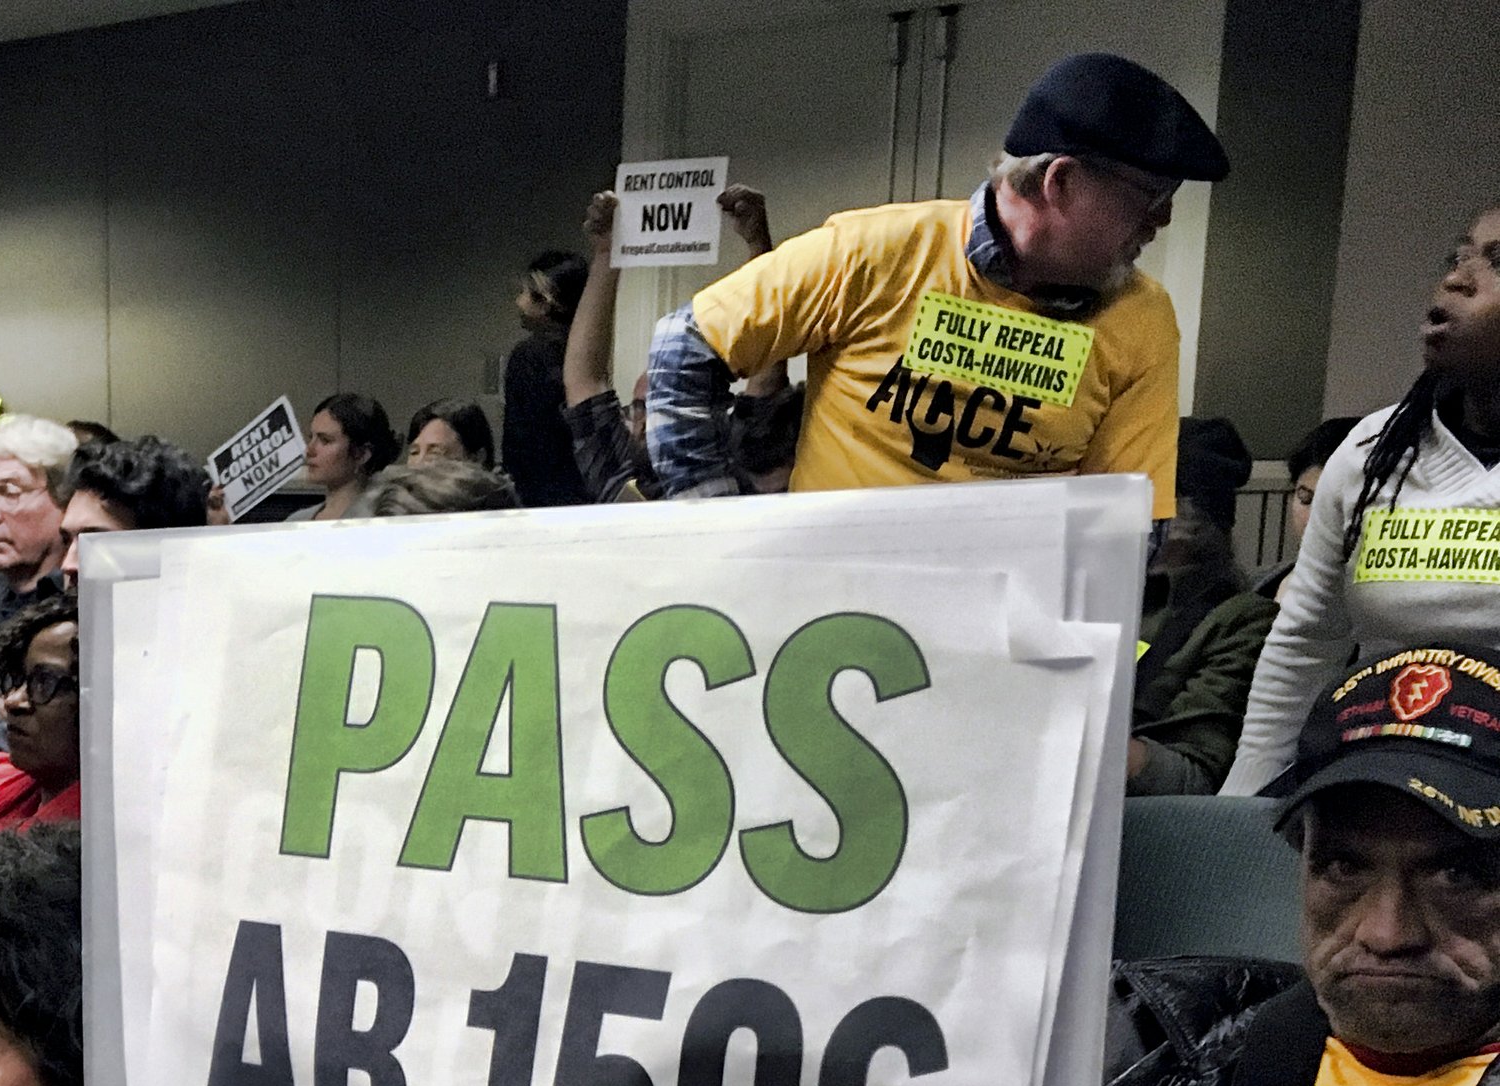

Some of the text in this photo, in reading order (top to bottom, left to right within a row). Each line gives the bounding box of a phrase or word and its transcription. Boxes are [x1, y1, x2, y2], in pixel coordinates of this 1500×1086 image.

[624, 169, 715, 192] RENT CONTROL
[641, 202, 692, 232] NOW
[934, 310, 1065, 362] FULLY REPEAL
[917, 337, 1069, 394] COSTA-HAWKINS
[220, 425, 294, 485] CONTROL
[231, 420, 270, 460] RENT
[241, 452, 280, 491] NOW
[1379, 519, 1435, 540] FULLY
[1376, 649, 1464, 675] INFANTRY
[279, 593, 931, 915] PASS
